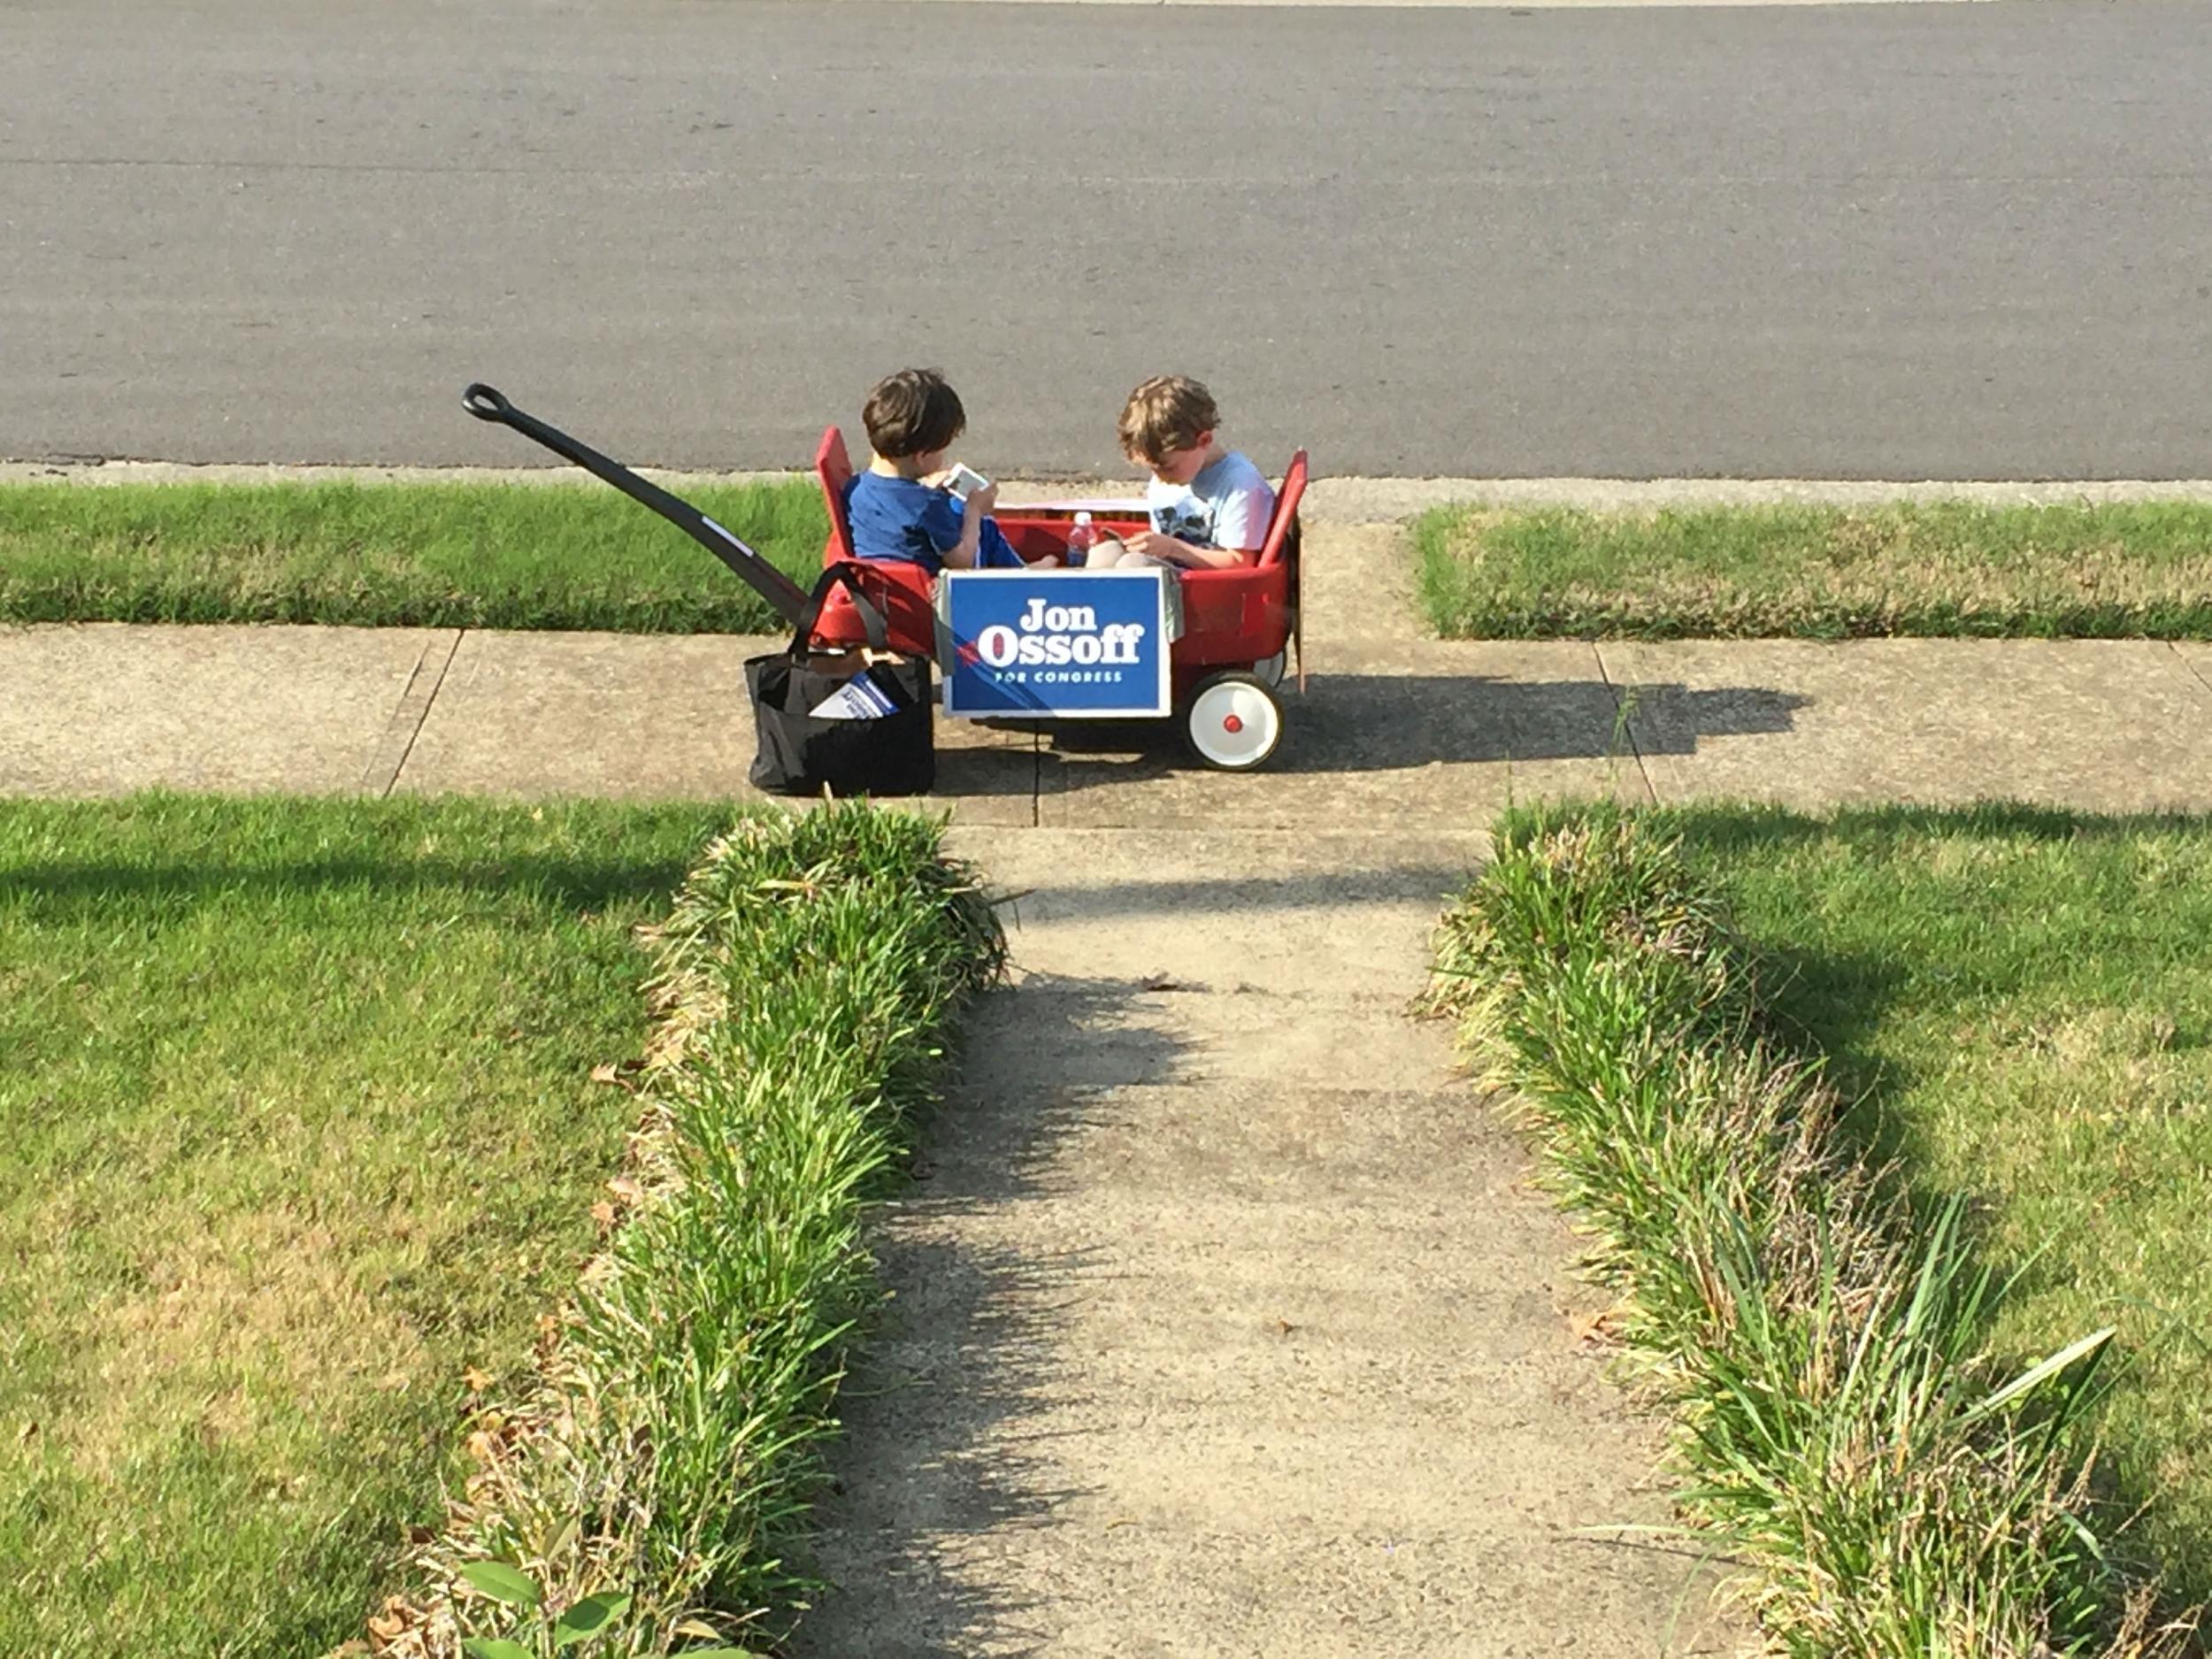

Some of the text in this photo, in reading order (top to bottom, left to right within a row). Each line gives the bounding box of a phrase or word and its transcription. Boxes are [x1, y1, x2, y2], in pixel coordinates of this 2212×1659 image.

[1020, 599, 1097, 632] Jon
[978, 624, 1145, 667] Ossoff
[995, 671, 1123, 683] FOR CONGRESS
